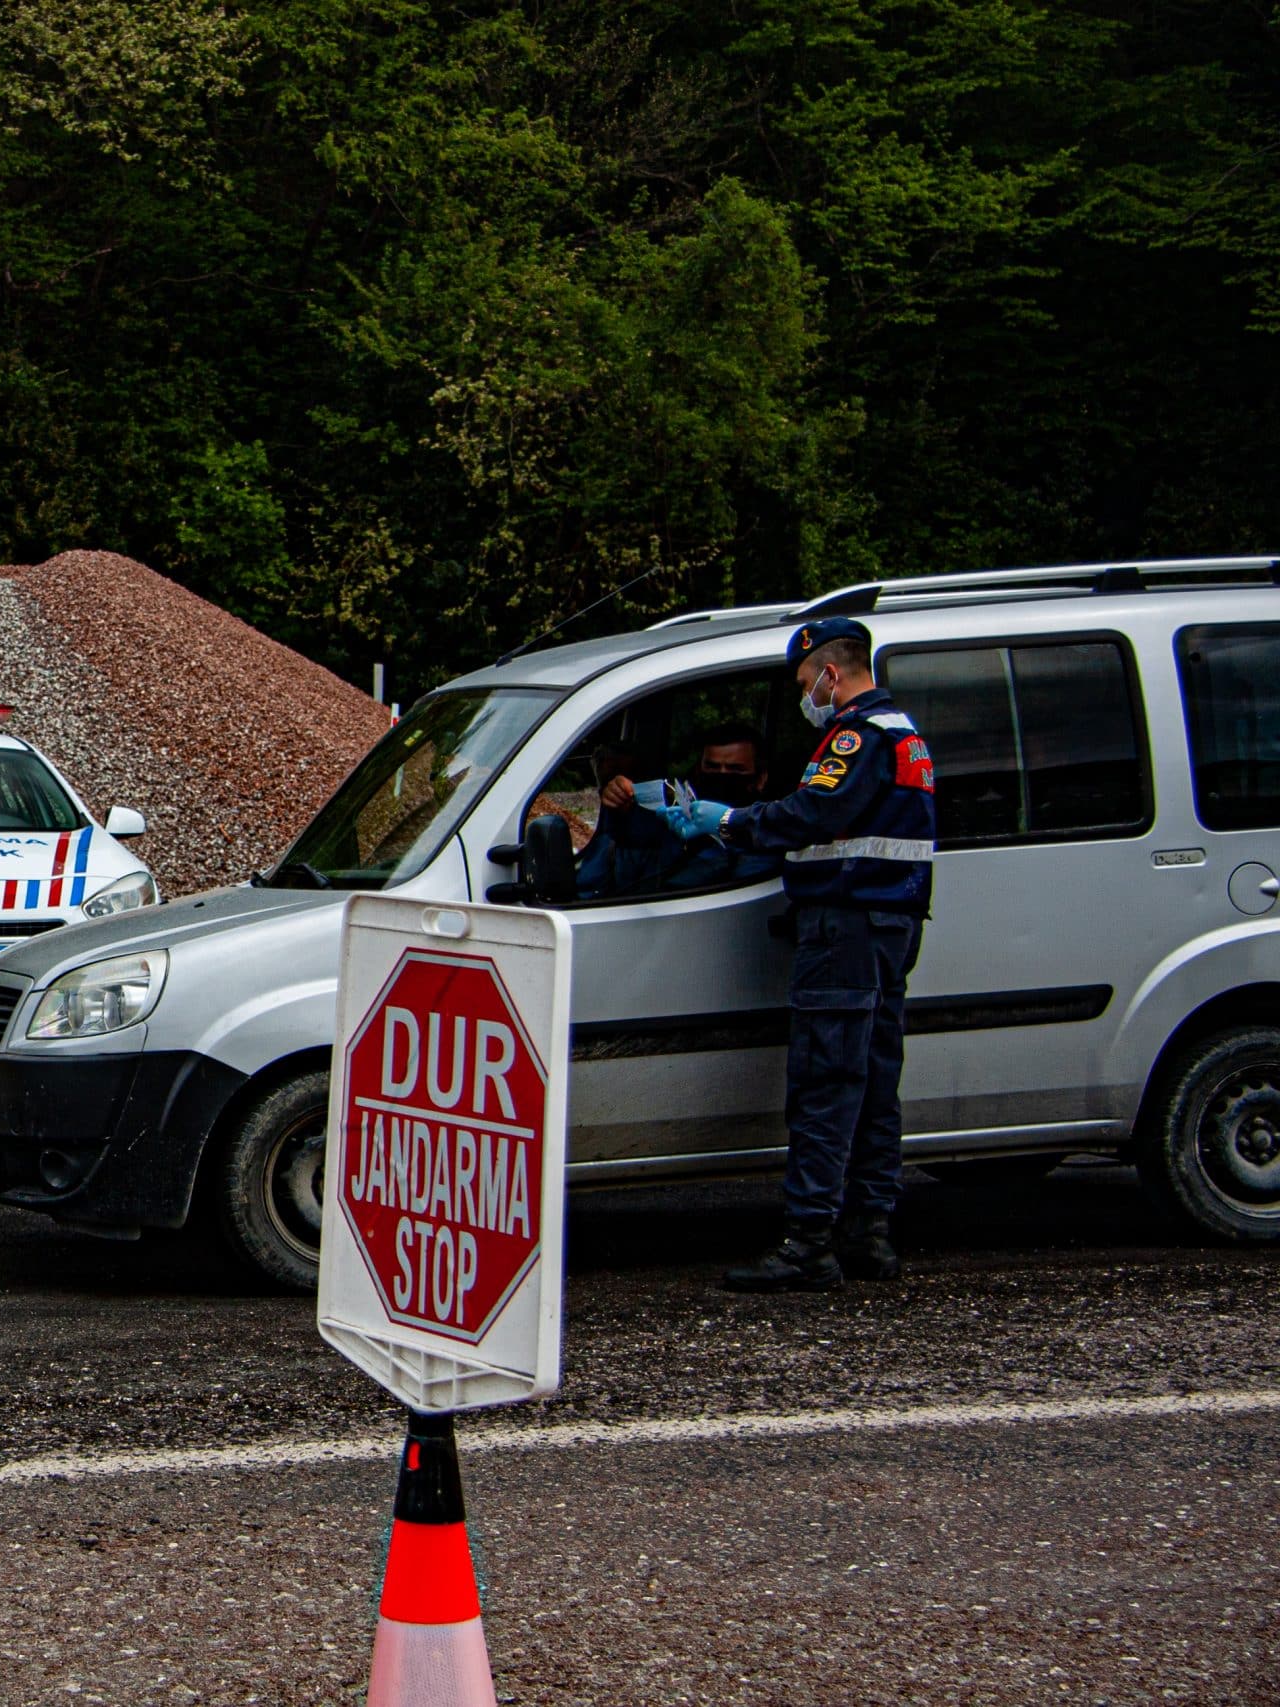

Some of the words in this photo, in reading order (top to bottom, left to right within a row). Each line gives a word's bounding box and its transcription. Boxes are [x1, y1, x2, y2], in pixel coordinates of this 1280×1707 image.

[380, 1005, 517, 1121] DUR
[351, 1110, 531, 1240] JANDARMA
[392, 1216, 478, 1326] STOP
